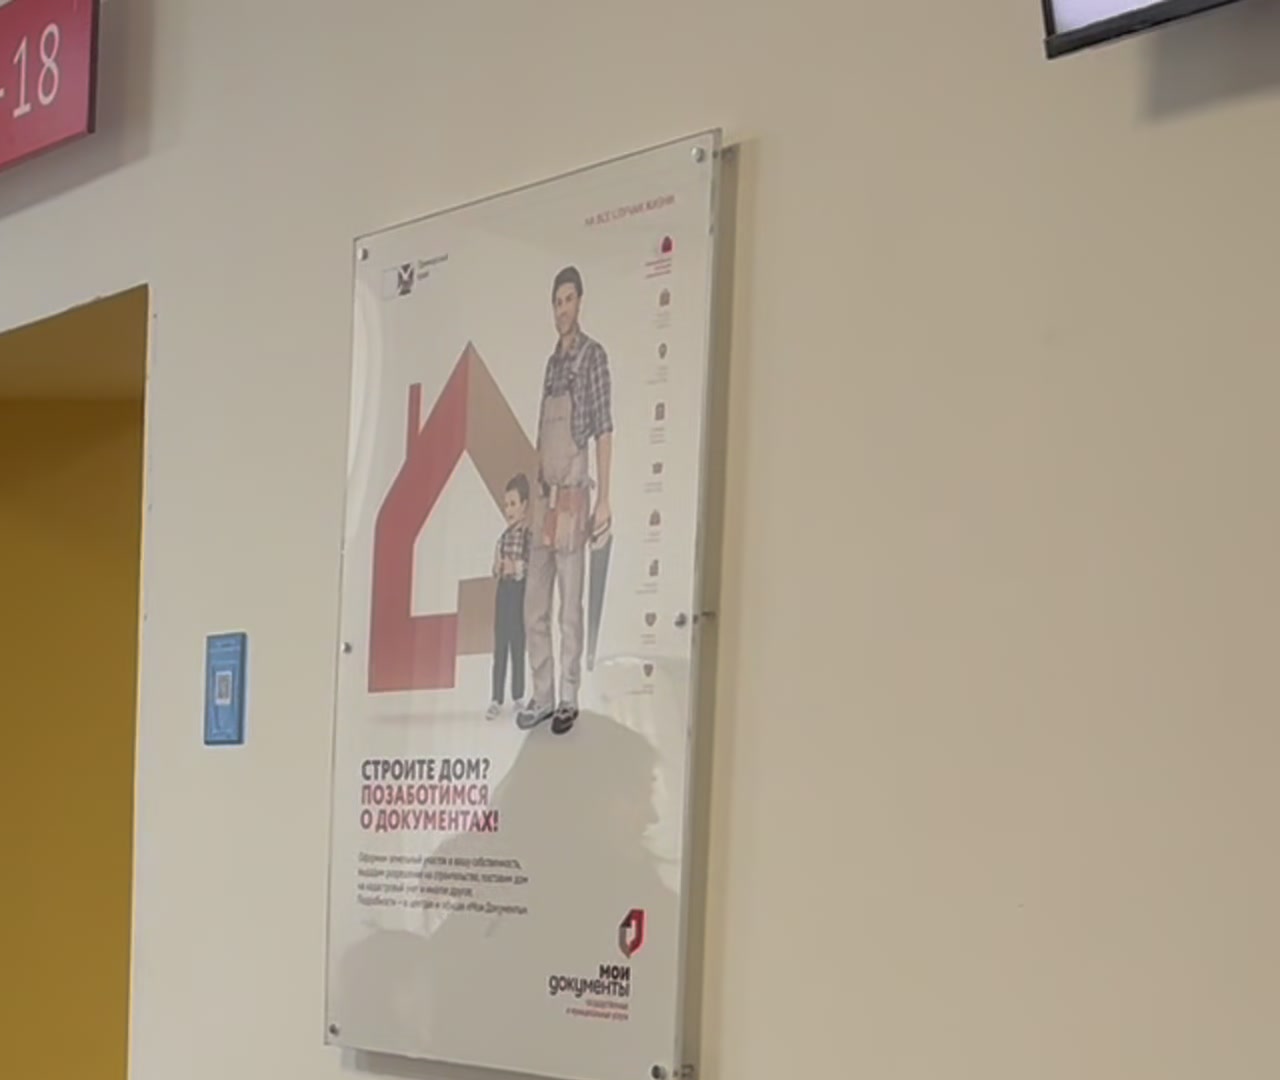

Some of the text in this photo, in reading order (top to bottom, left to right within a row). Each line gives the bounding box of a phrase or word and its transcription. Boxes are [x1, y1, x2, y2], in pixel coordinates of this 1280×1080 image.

[362, 758, 490, 782] СТРОИТЕ ДОМ?
[361, 785, 488, 805] ПОЗАБОТИМСЯ
[361, 809, 499, 832] О ДОКУМЕНТАХ!
[549, 975, 630, 998] документы
